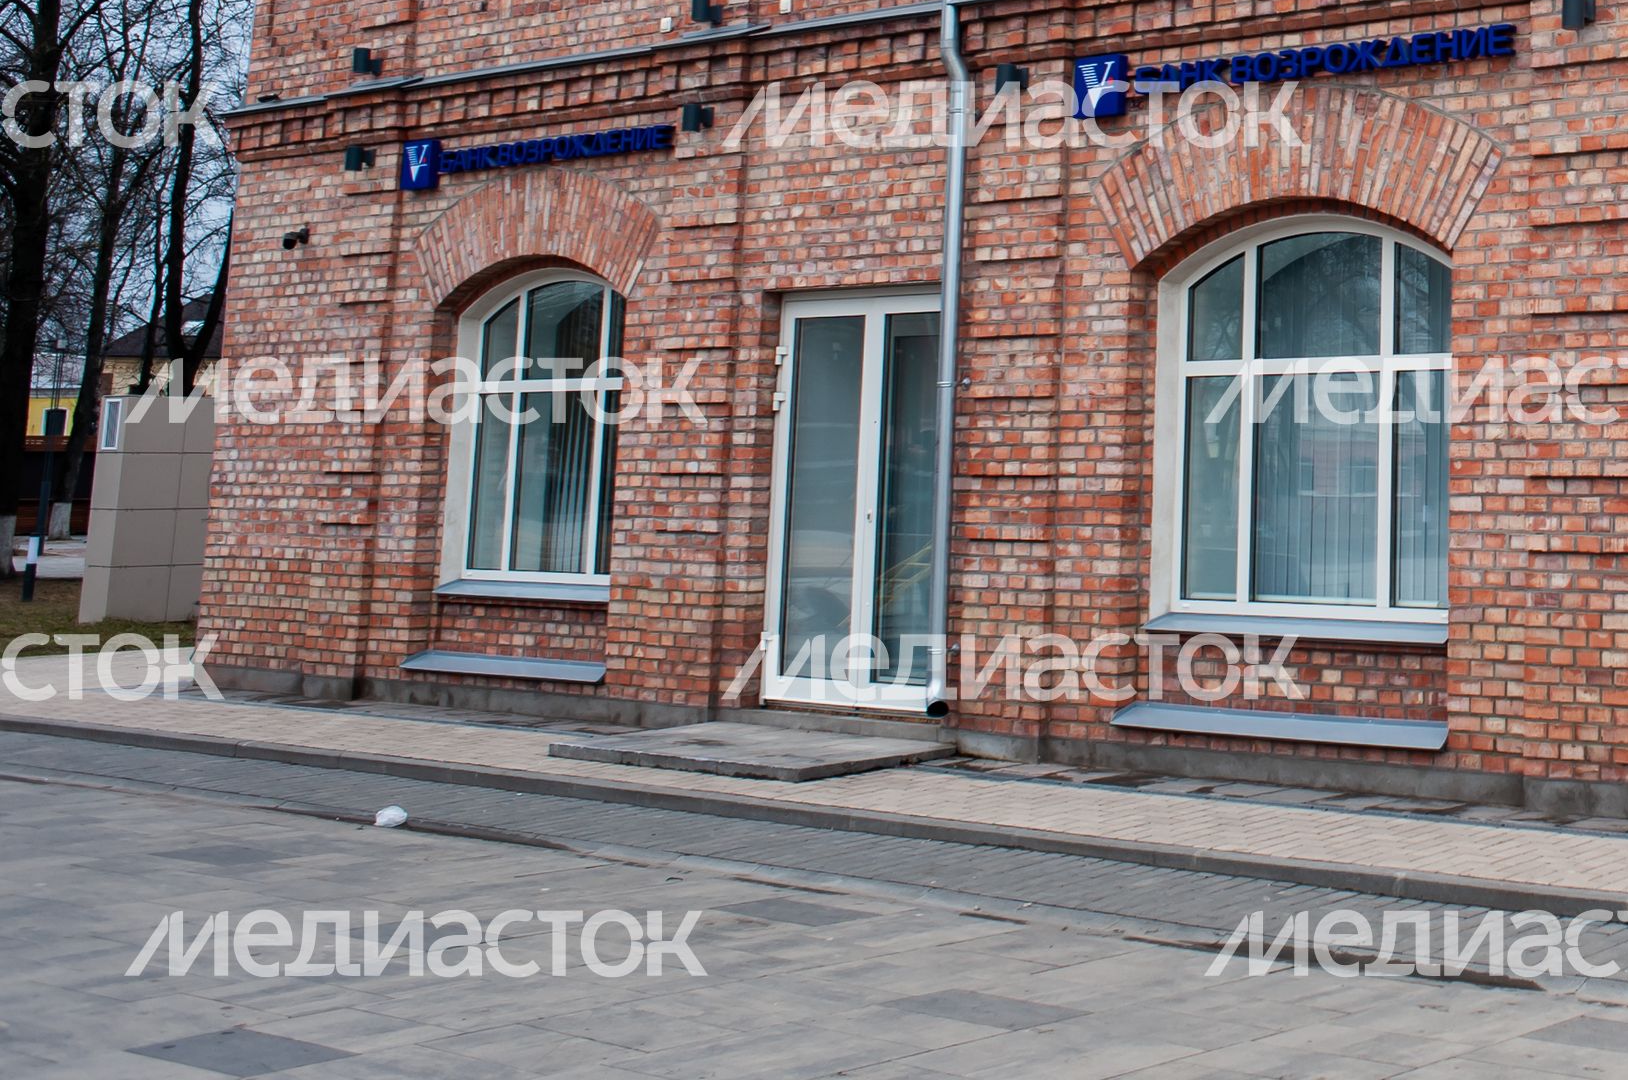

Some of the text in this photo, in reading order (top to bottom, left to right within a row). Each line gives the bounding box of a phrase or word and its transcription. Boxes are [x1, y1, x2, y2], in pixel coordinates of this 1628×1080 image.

[1135, 24, 1516, 95] БАНК ВОЗРОЖДЕНИЕ
[440, 125, 676, 173] БАНК ВОЗРОЖДЕНИЕ
